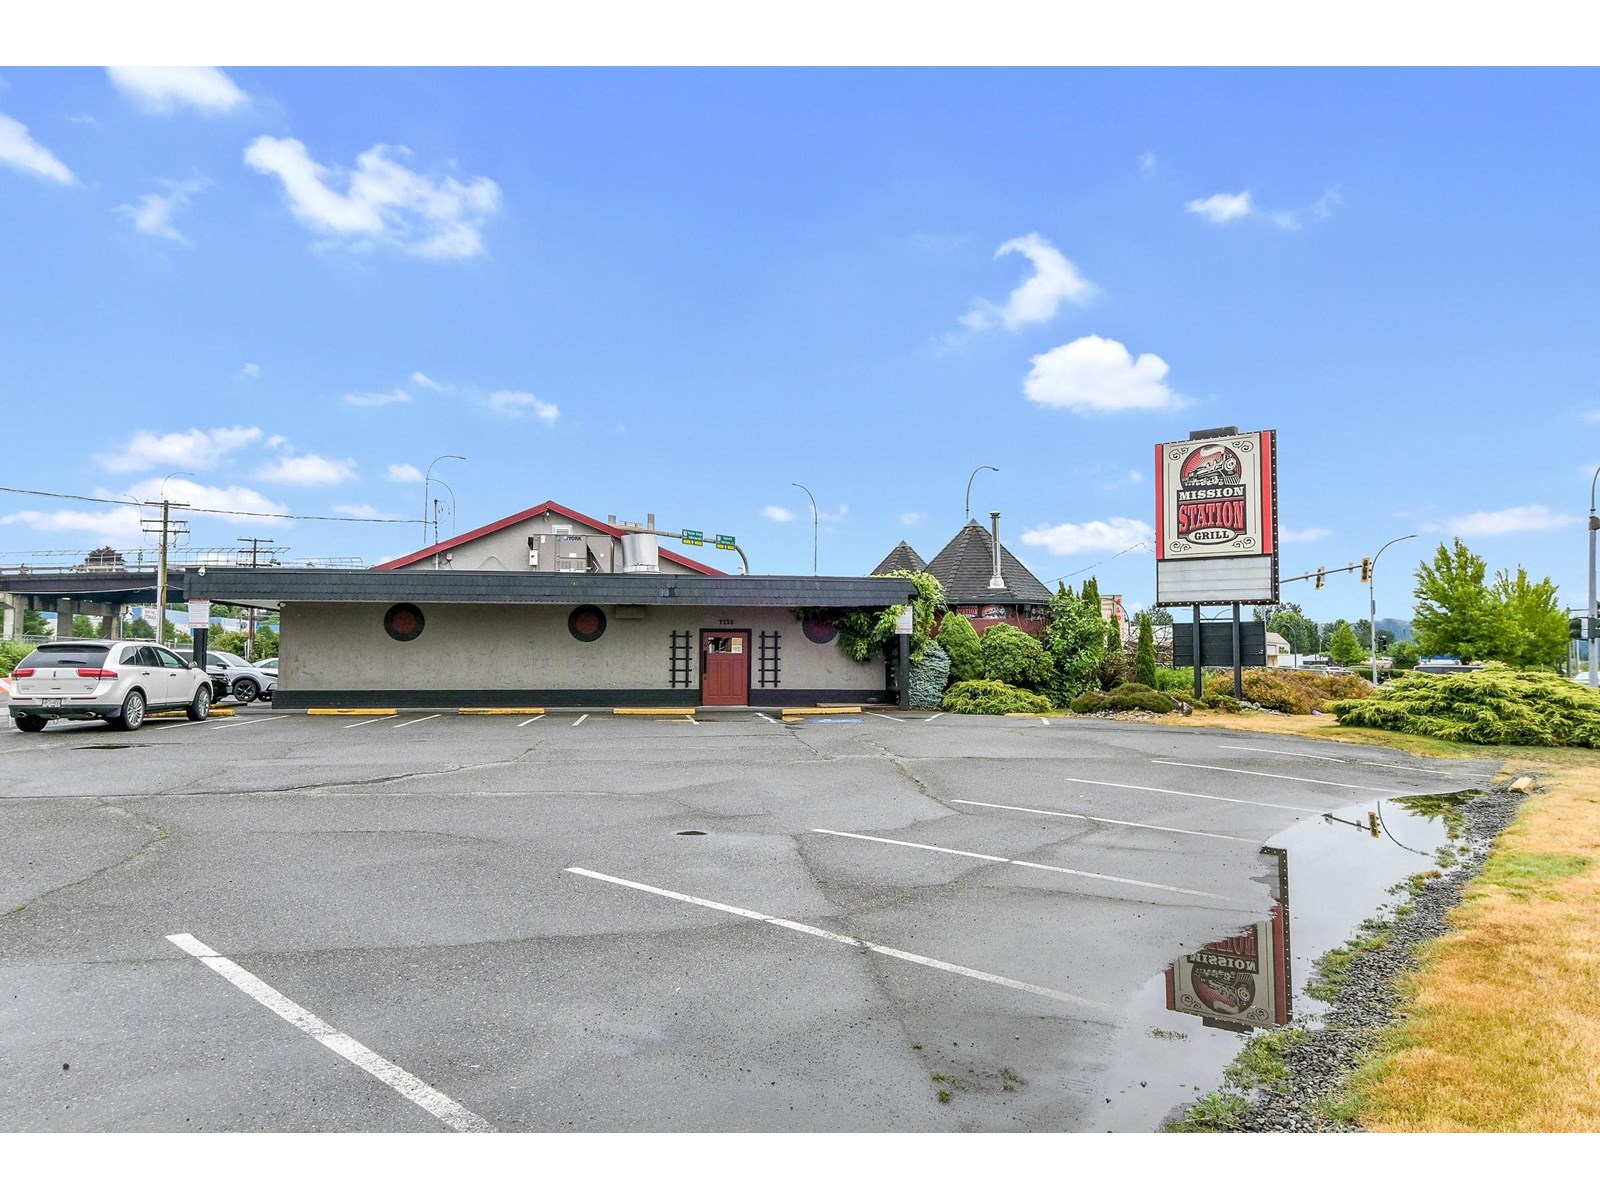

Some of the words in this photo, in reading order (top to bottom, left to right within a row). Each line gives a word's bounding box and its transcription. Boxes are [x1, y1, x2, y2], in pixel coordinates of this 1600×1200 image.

[1179, 487, 1244, 500] MISSION
[1179, 502, 1243, 532] STATION
[1195, 531, 1230, 541] GRILL
